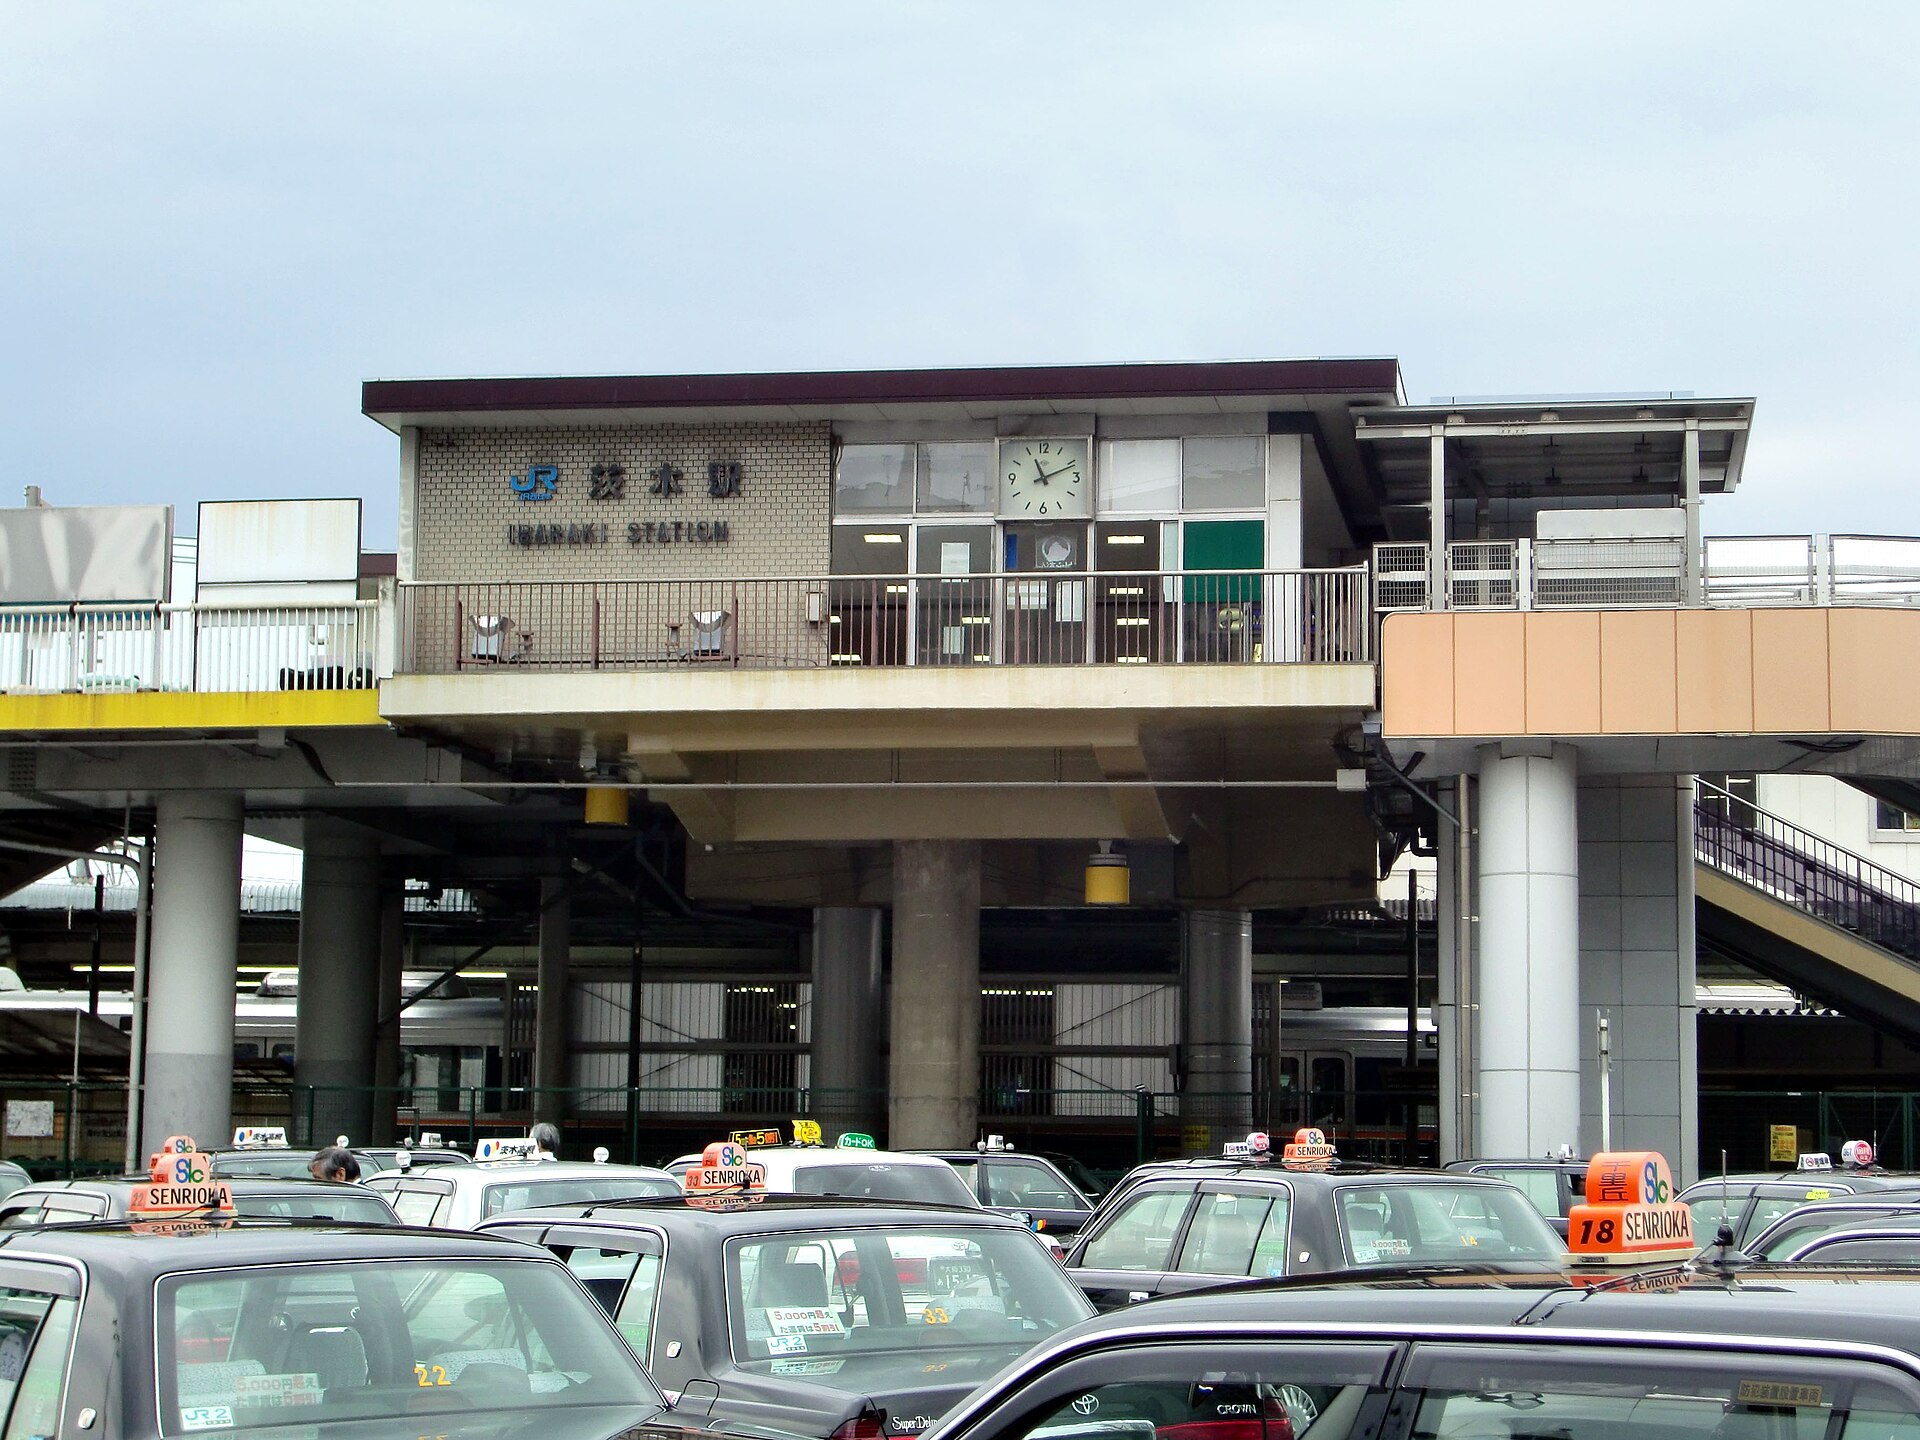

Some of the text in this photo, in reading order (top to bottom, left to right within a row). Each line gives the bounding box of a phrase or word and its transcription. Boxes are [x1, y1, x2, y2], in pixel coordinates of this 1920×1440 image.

[1039, 443, 1049, 454] 12
[510, 465, 558, 492] JR
[589, 462, 741, 499] 茨木駅
[1008, 472, 1016, 485] 9
[1072, 471, 1081, 484] 3
[1039, 502, 1048, 515] 6
[509, 520, 729, 546] IBARAKI STATION
[1297, 1146, 1333, 1156] SENRIOKA
[704, 1170, 761, 1185] SENRIOKA
[150, 1187, 228, 1205] SENRIOKA
[1580, 1210, 1690, 1245] 18 SENRIOKA
[921, 1307, 950, 1325] 33
[412, 1365, 452, 1388] 22
[185, 1408, 227, 1421] JR 2
[1216, 1404, 1257, 1415] CROWN
